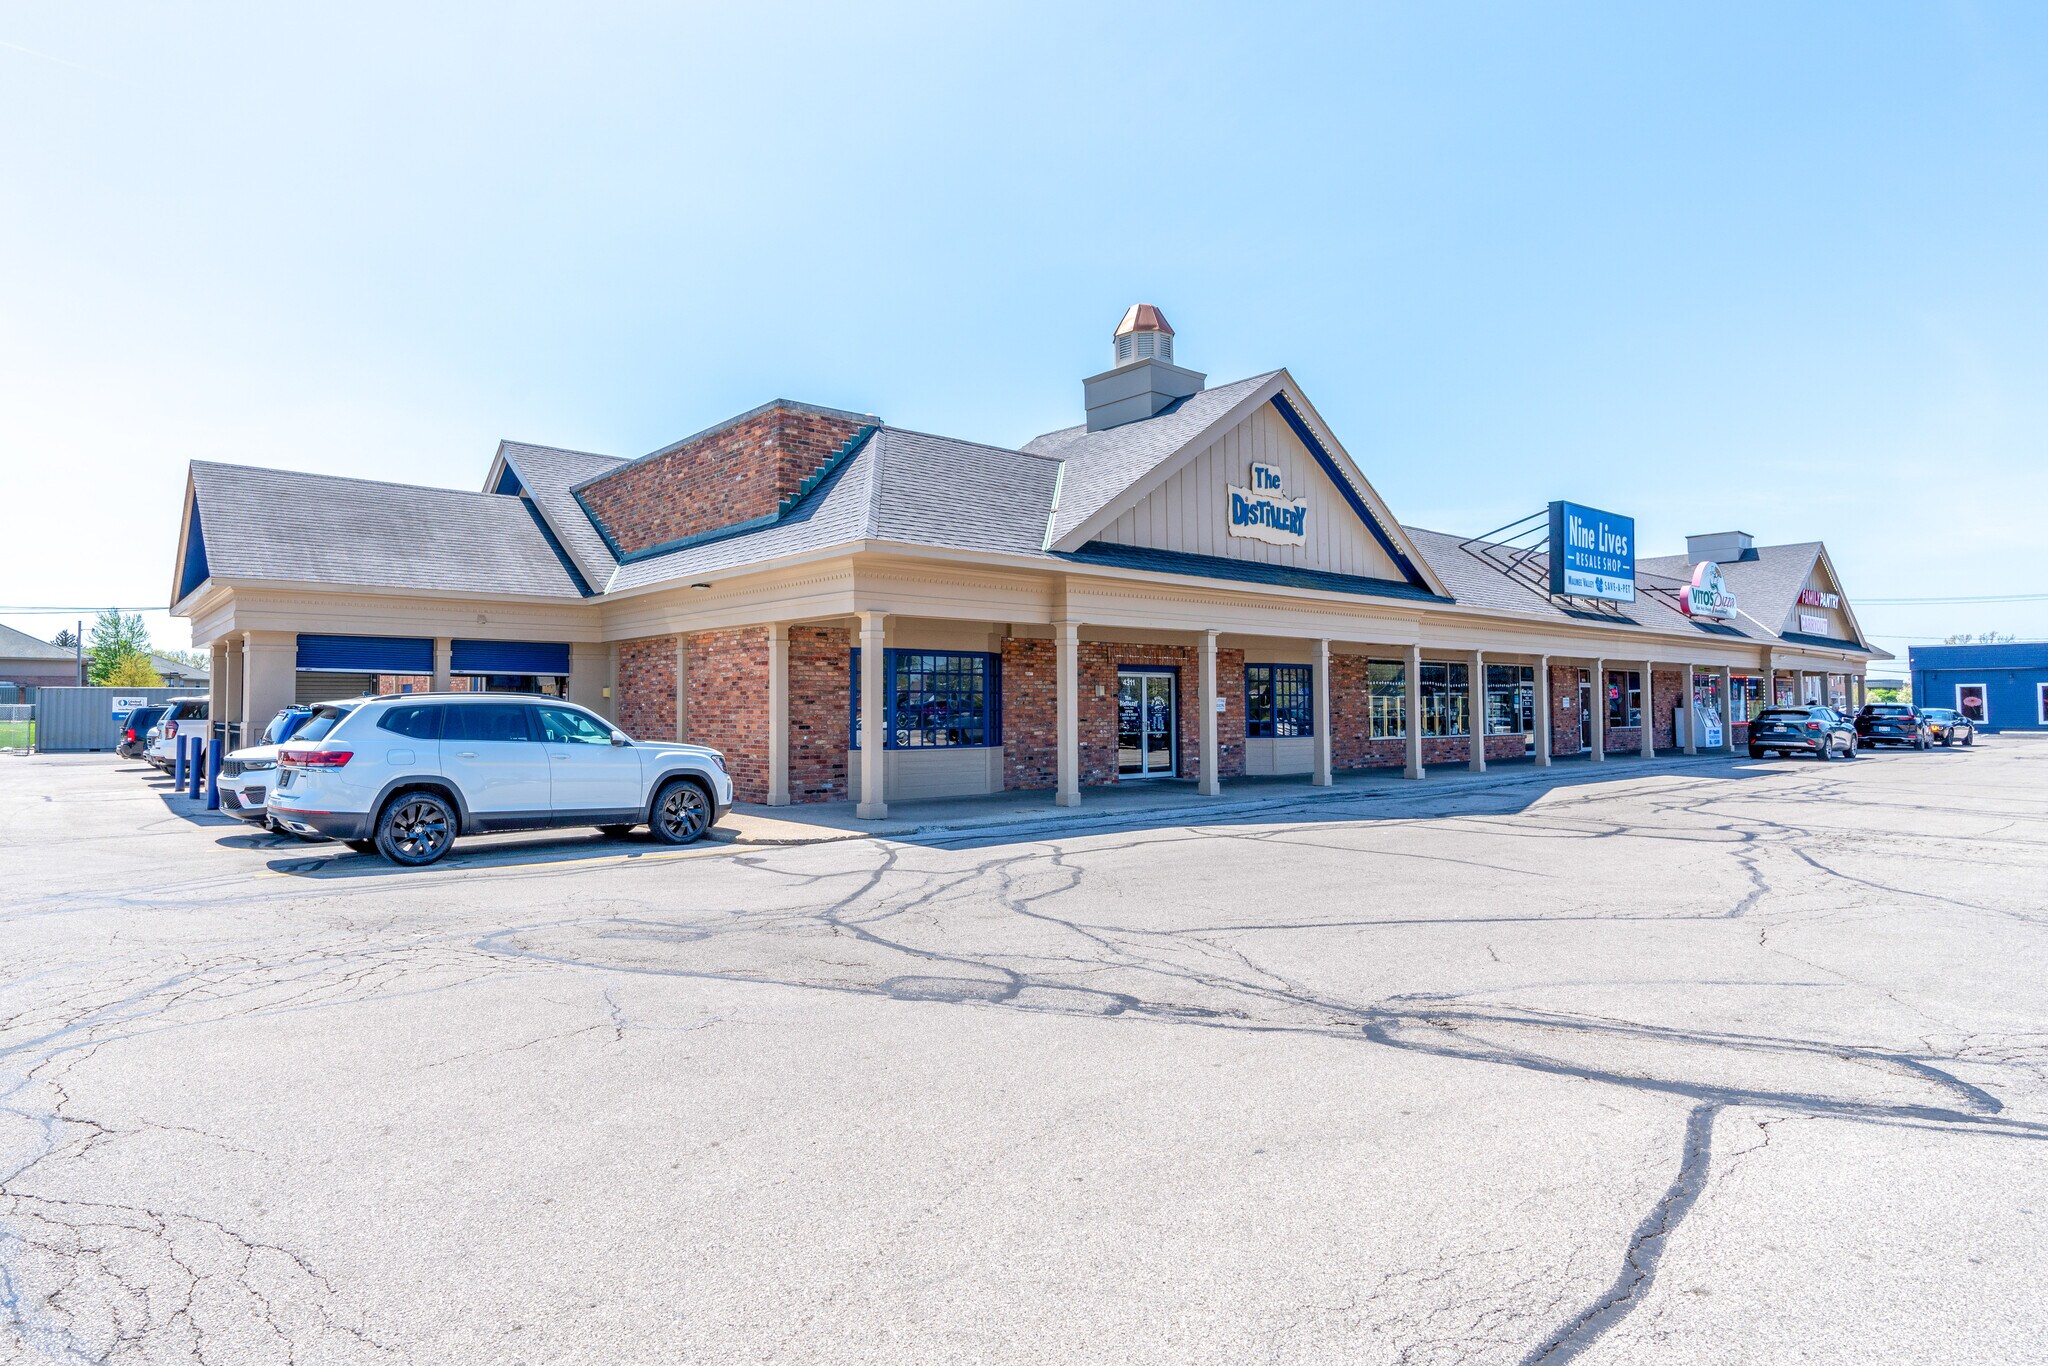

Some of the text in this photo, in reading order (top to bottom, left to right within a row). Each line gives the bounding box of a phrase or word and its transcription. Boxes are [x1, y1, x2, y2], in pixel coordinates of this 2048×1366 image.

[1255, 467, 1280, 488] The
[1570, 515, 1628, 556] Nine Lives
[1576, 552, 1621, 572] RESALE SHOP
[1604, 581, 1630, 594] SAVE-A-PET
[1692, 587, 1714, 606] VITO'S
[1802, 589, 1839, 609] FAMILY PANTRY
